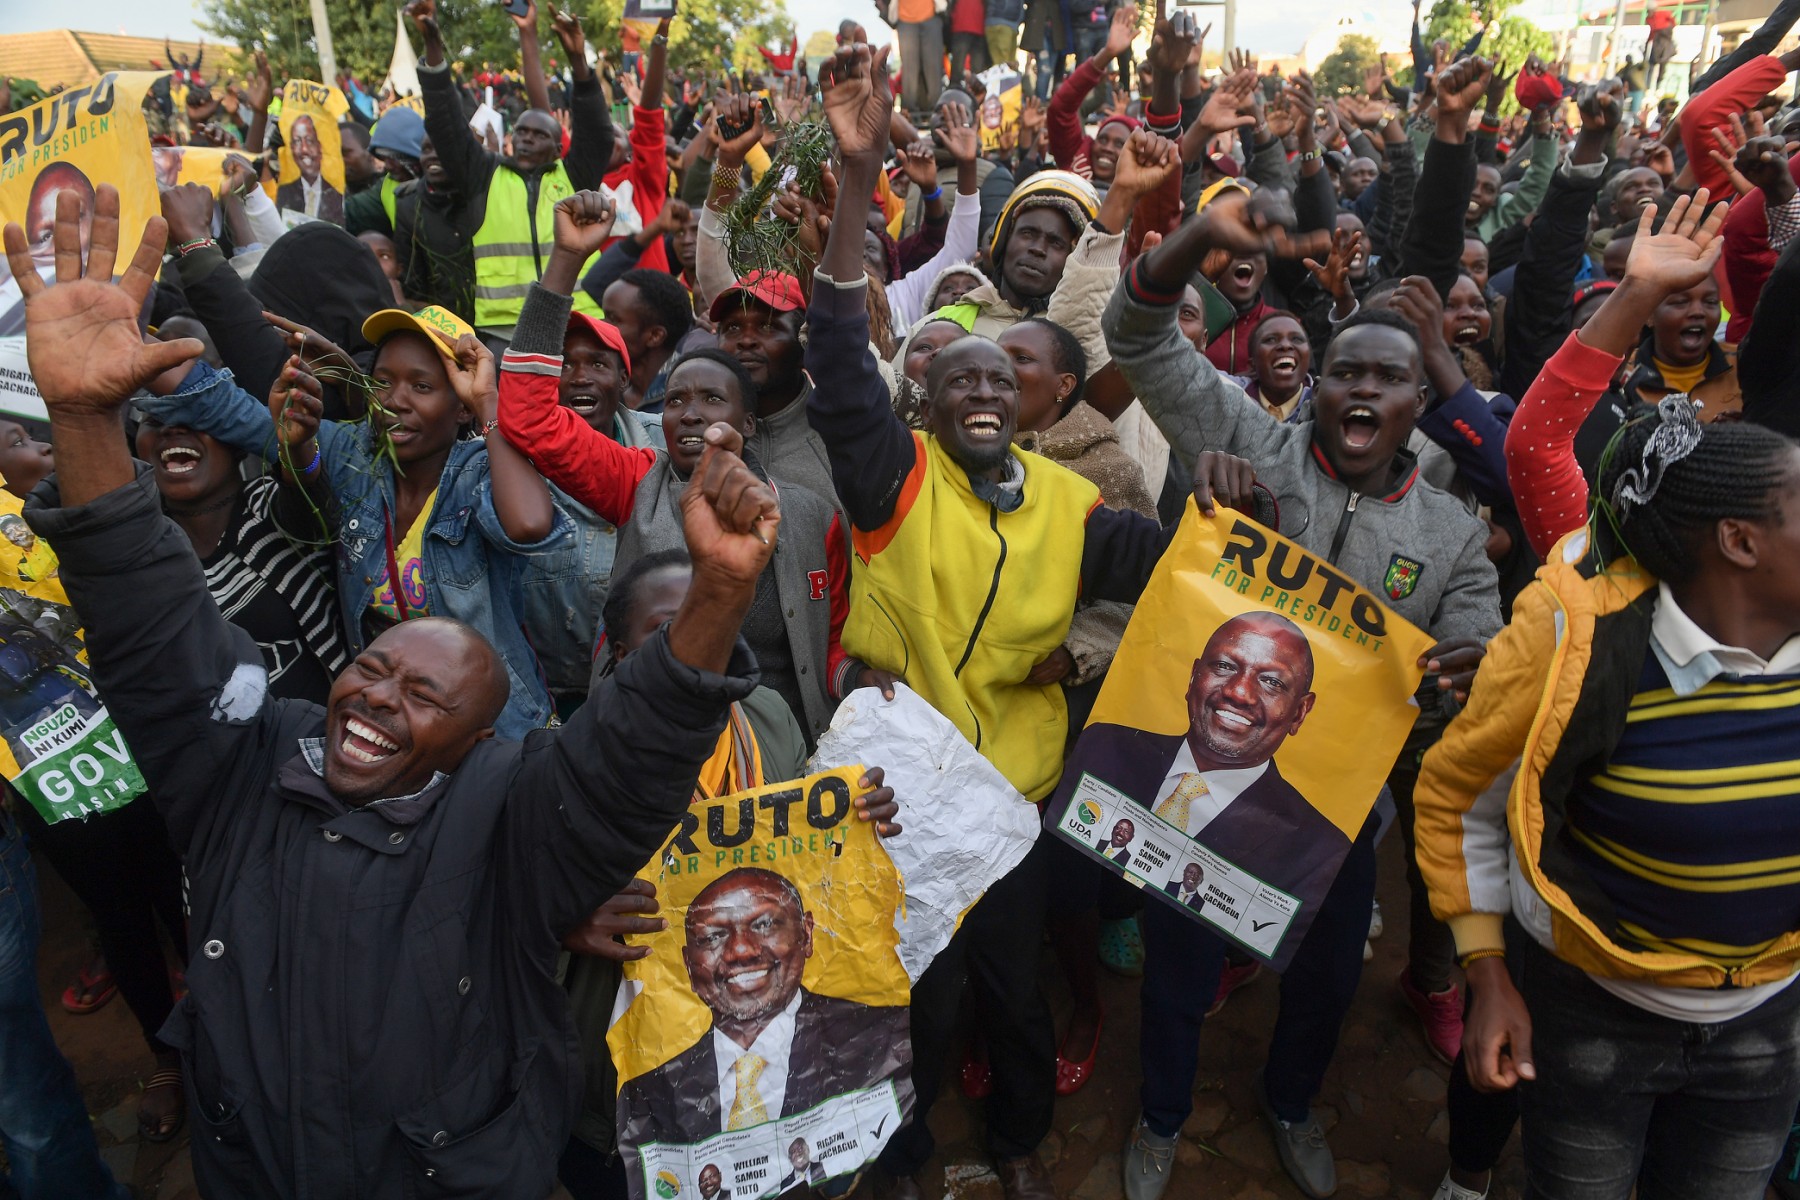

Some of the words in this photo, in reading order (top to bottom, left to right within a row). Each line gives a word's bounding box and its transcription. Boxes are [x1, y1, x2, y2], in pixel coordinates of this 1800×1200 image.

[290, 82, 330, 105] RUTO
[0, 73, 119, 165] RUTO
[808, 569, 828, 599] P
[1221, 519, 1388, 638] RUTO
[1210, 562, 1251, 595] FOR
[1260, 585, 1384, 652] PRESIDENT
[23, 706, 76, 745] NGUZO
[34, 740, 53, 756] NI
[51, 719, 87, 746] KUMI
[38, 728, 131, 803] GOV
[662, 776, 851, 865] RUTO
[1069, 818, 1092, 839] UDA
[716, 825, 849, 868] PRESIDENT
[1138, 848, 1164, 869] SAMOEI
[1143, 839, 1171, 862] WILLIAM
[1133, 857, 1152, 873] RUTO
[1203, 892, 1240, 920] GACHAGUA
[1207, 883, 1235, 905] RIGATHI
[733, 1155, 769, 1172] WILLIAM
[735, 1168, 767, 1184] SAMOEI
[736, 1183, 759, 1197] RUTO
